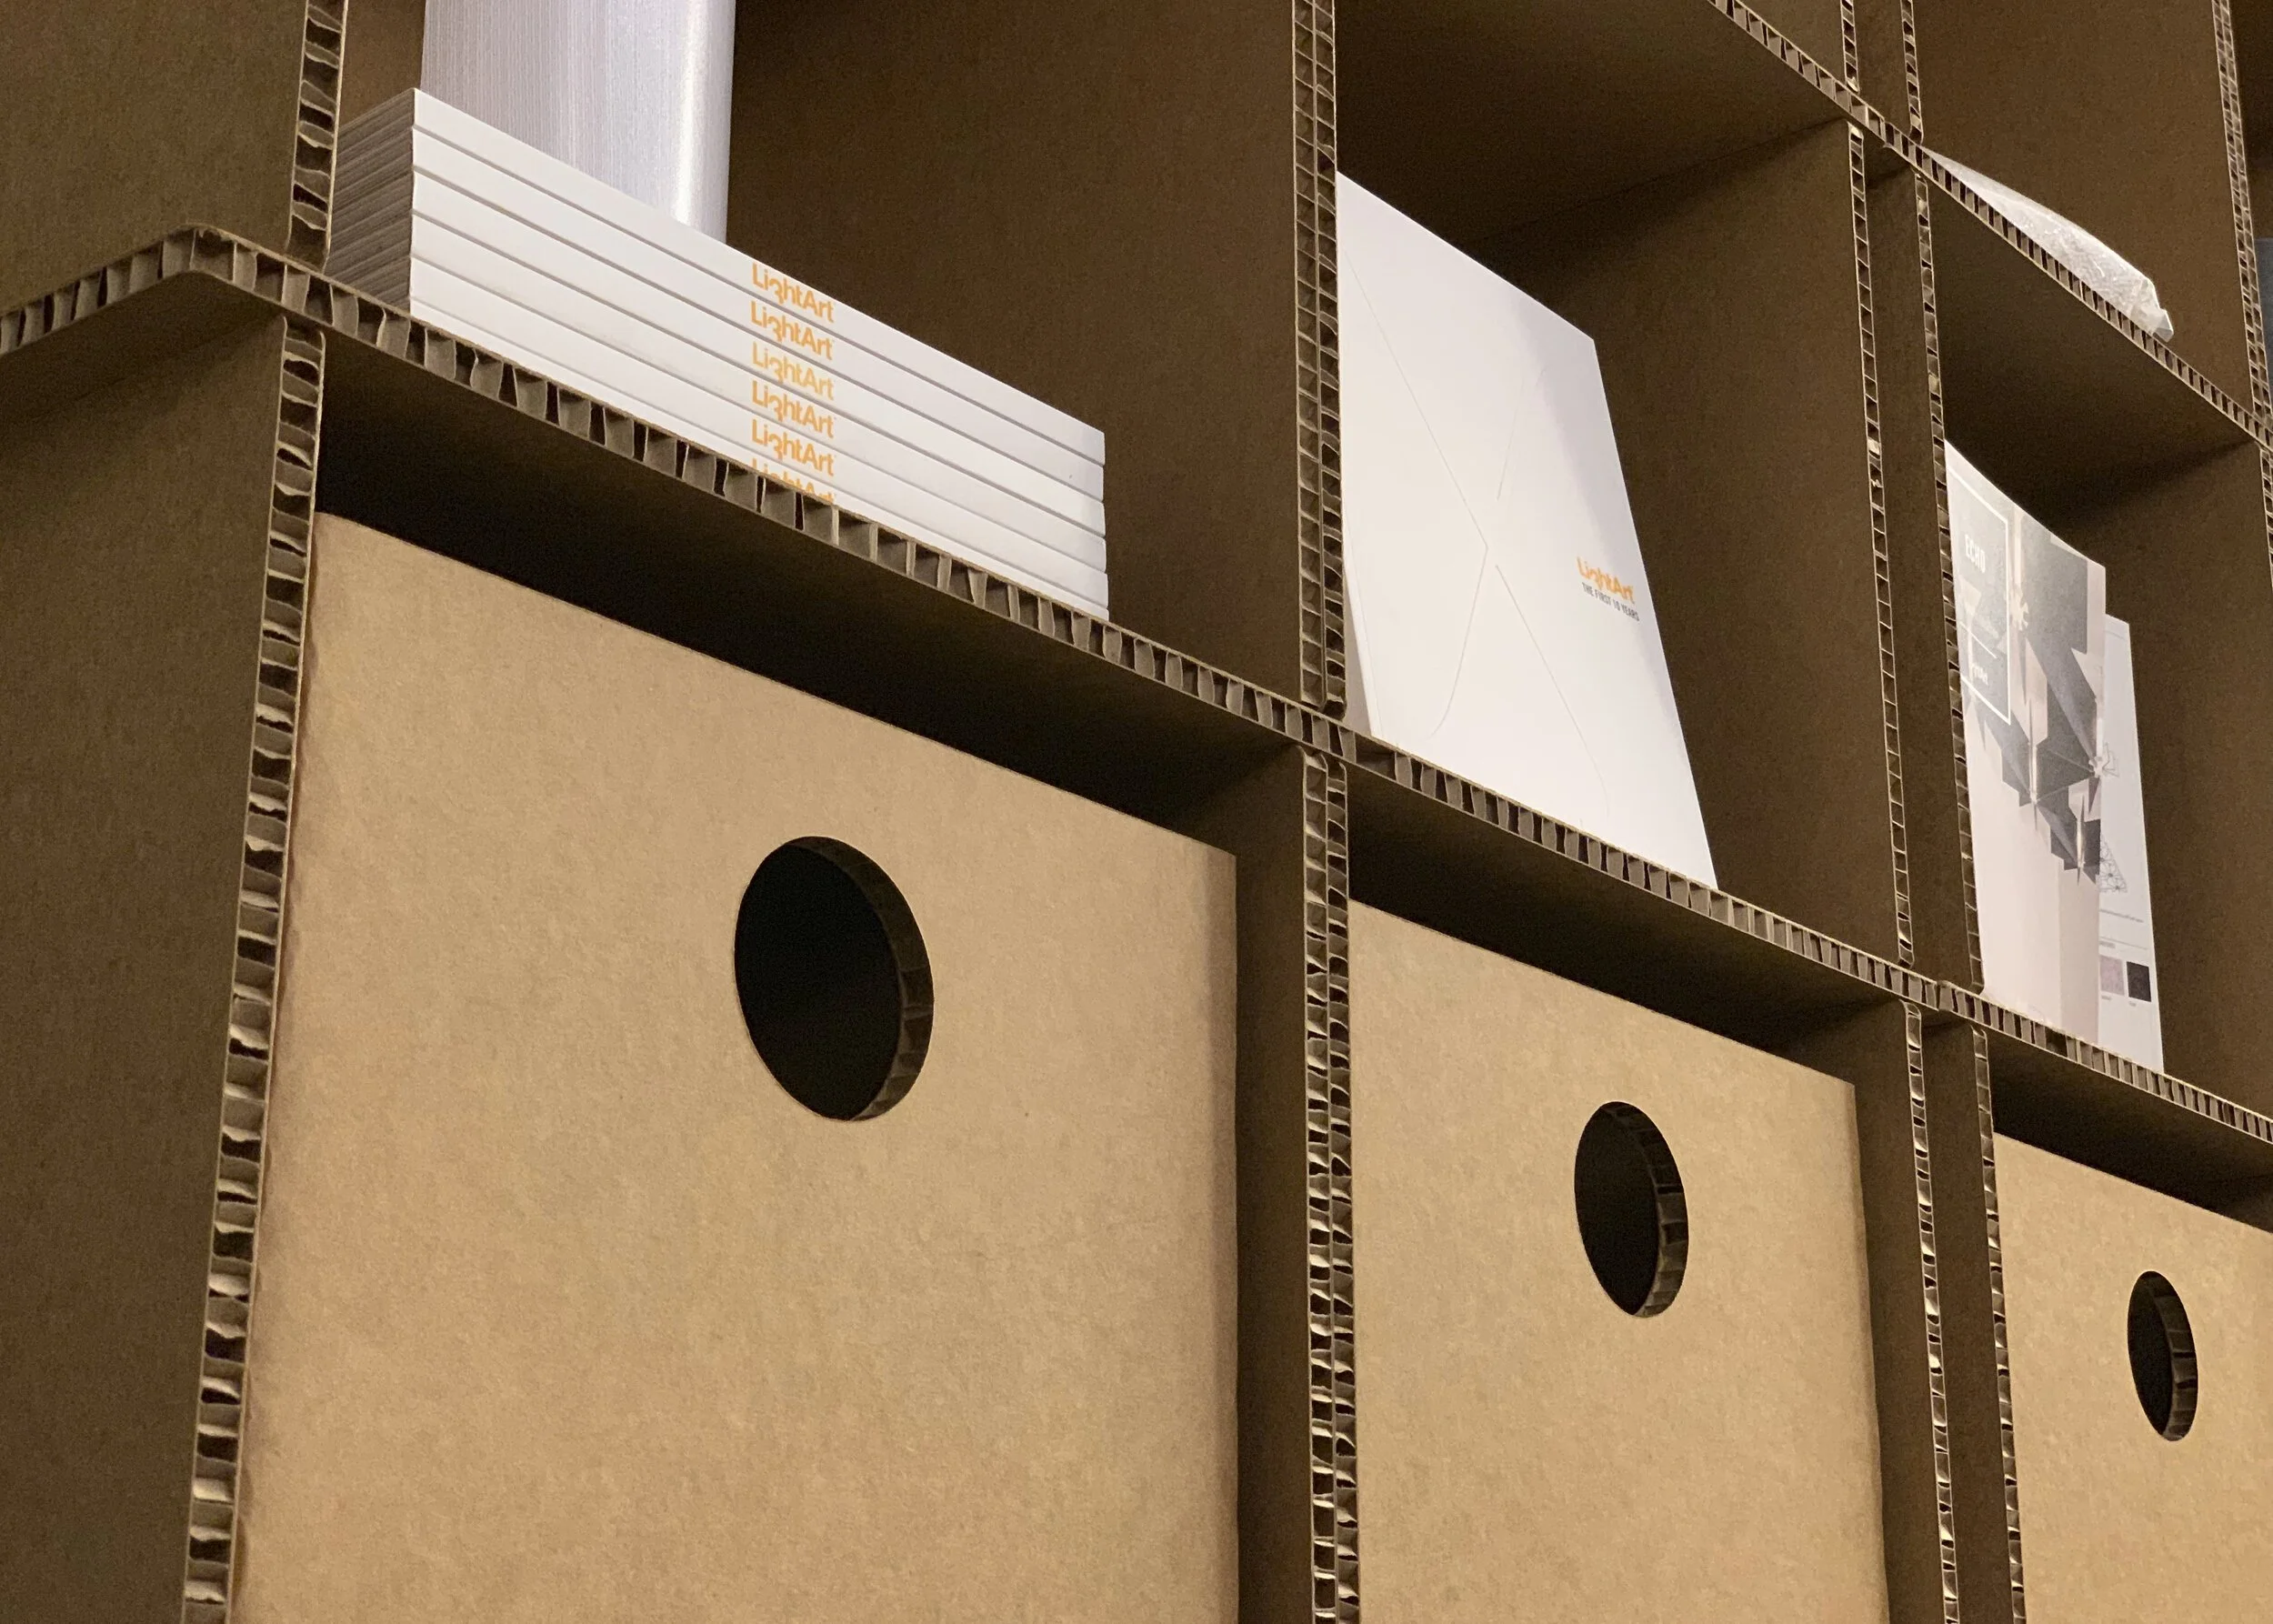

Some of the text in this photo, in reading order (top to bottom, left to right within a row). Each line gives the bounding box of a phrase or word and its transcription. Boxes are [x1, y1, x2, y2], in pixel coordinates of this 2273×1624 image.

[752, 262, 835, 324] LightArt
[750, 301, 835, 361] LightArt
[752, 341, 835, 400] LightArt
[752, 380, 836, 438] LightArt
[752, 418, 836, 477] LightArt
[1577, 556, 1635, 605] LightArt
[1595, 588, 1611, 606] FIRST
[1621, 603, 1639, 621] YEARS
